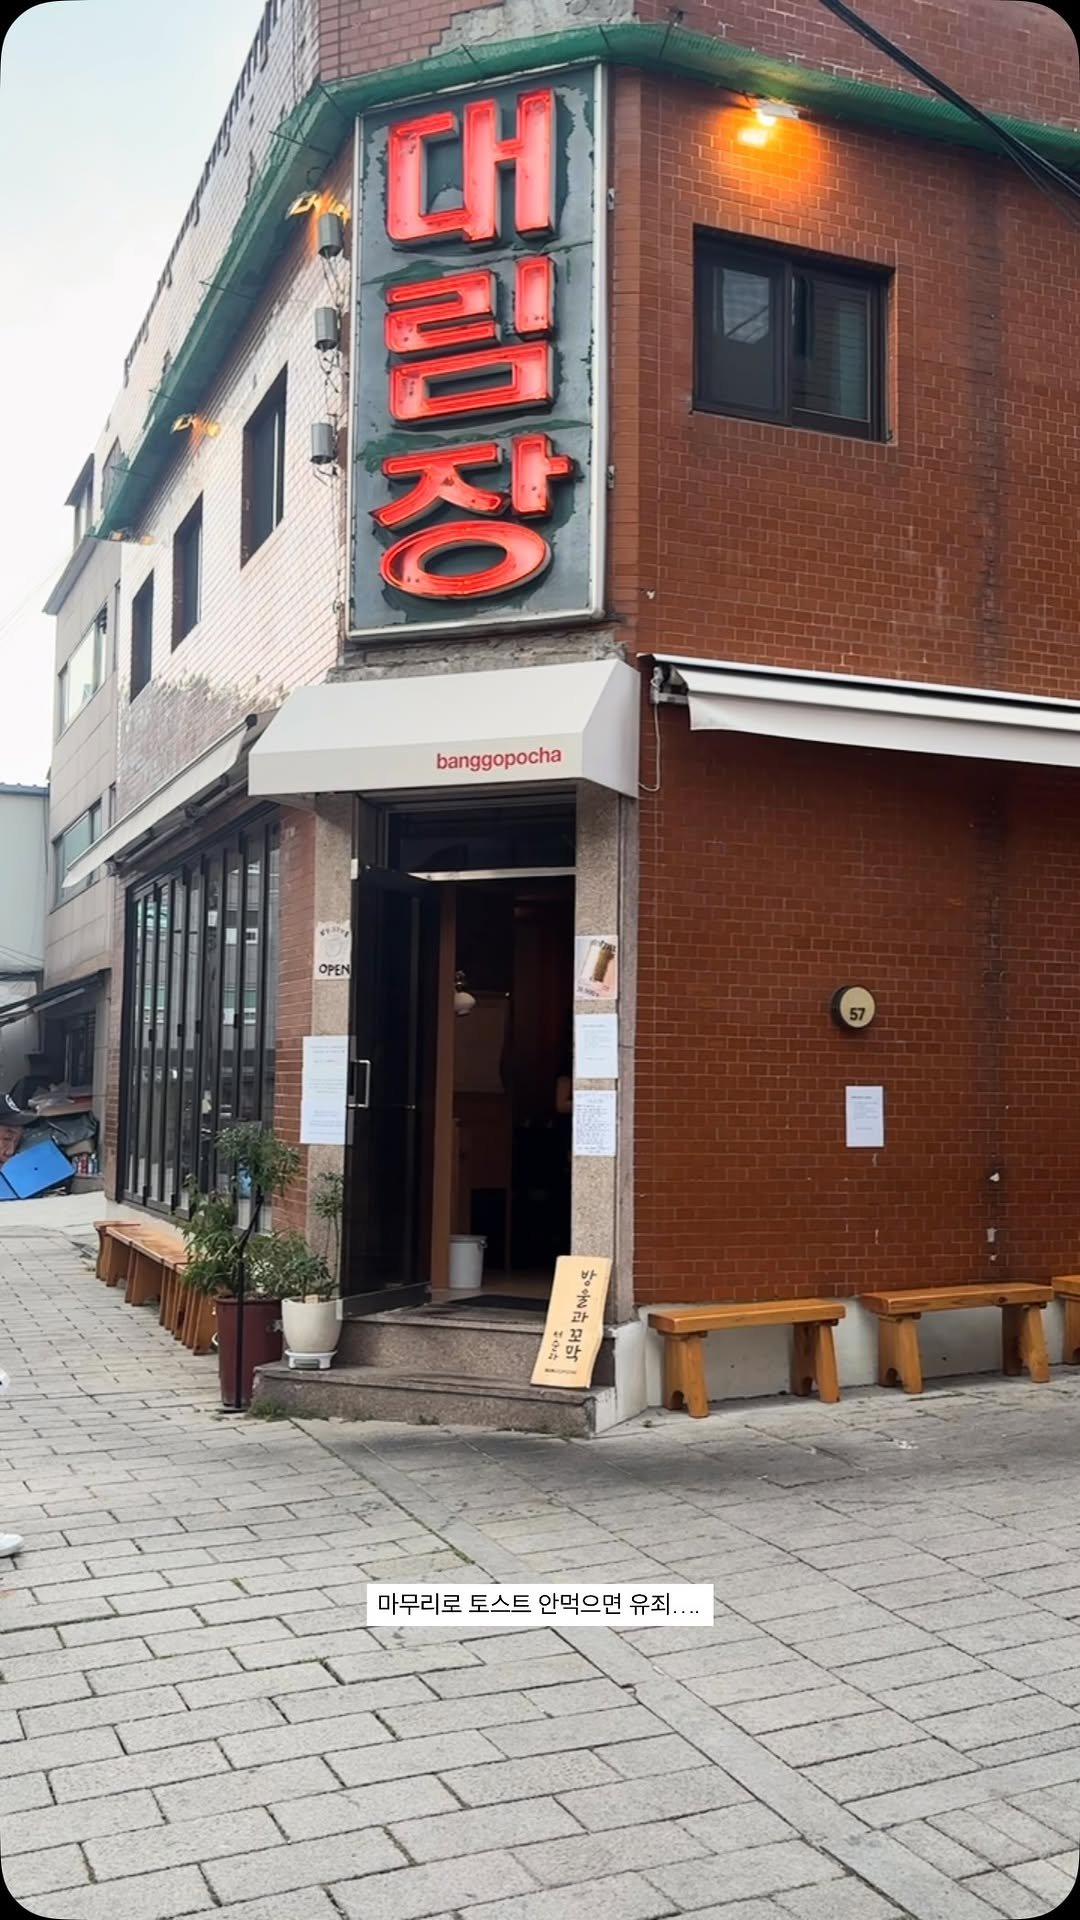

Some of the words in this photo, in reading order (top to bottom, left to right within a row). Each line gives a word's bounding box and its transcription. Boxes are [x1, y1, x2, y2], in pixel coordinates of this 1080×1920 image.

[373, 88, 576, 602] 대림장
[436, 747, 562, 772] banggopocha
[319, 963, 351, 977] OPEN
[849, 1007, 866, 1021] 57
